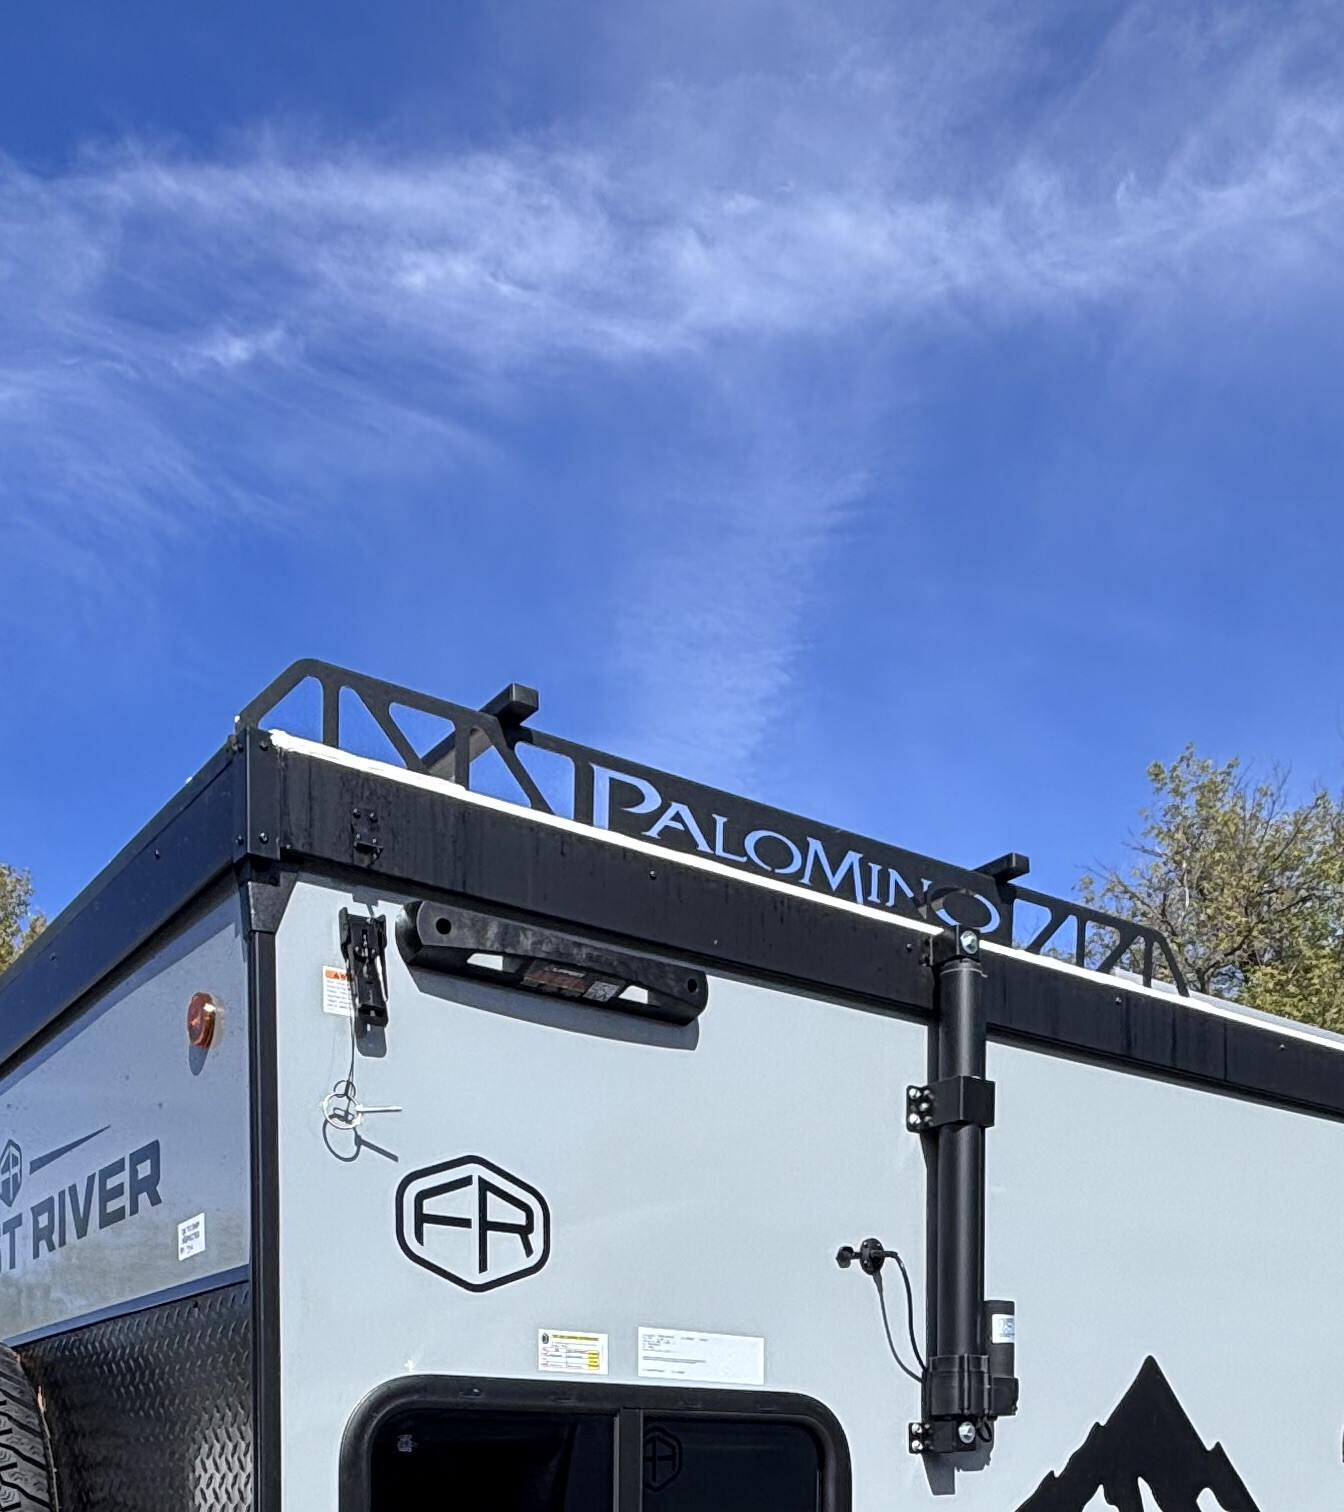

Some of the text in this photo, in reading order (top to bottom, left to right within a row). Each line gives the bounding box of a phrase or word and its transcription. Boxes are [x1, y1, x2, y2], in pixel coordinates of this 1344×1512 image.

[591, 763, 1001, 934] PALOMINO
[31, 1138, 163, 1259] RIVER
[413, 1173, 535, 1275] FR
